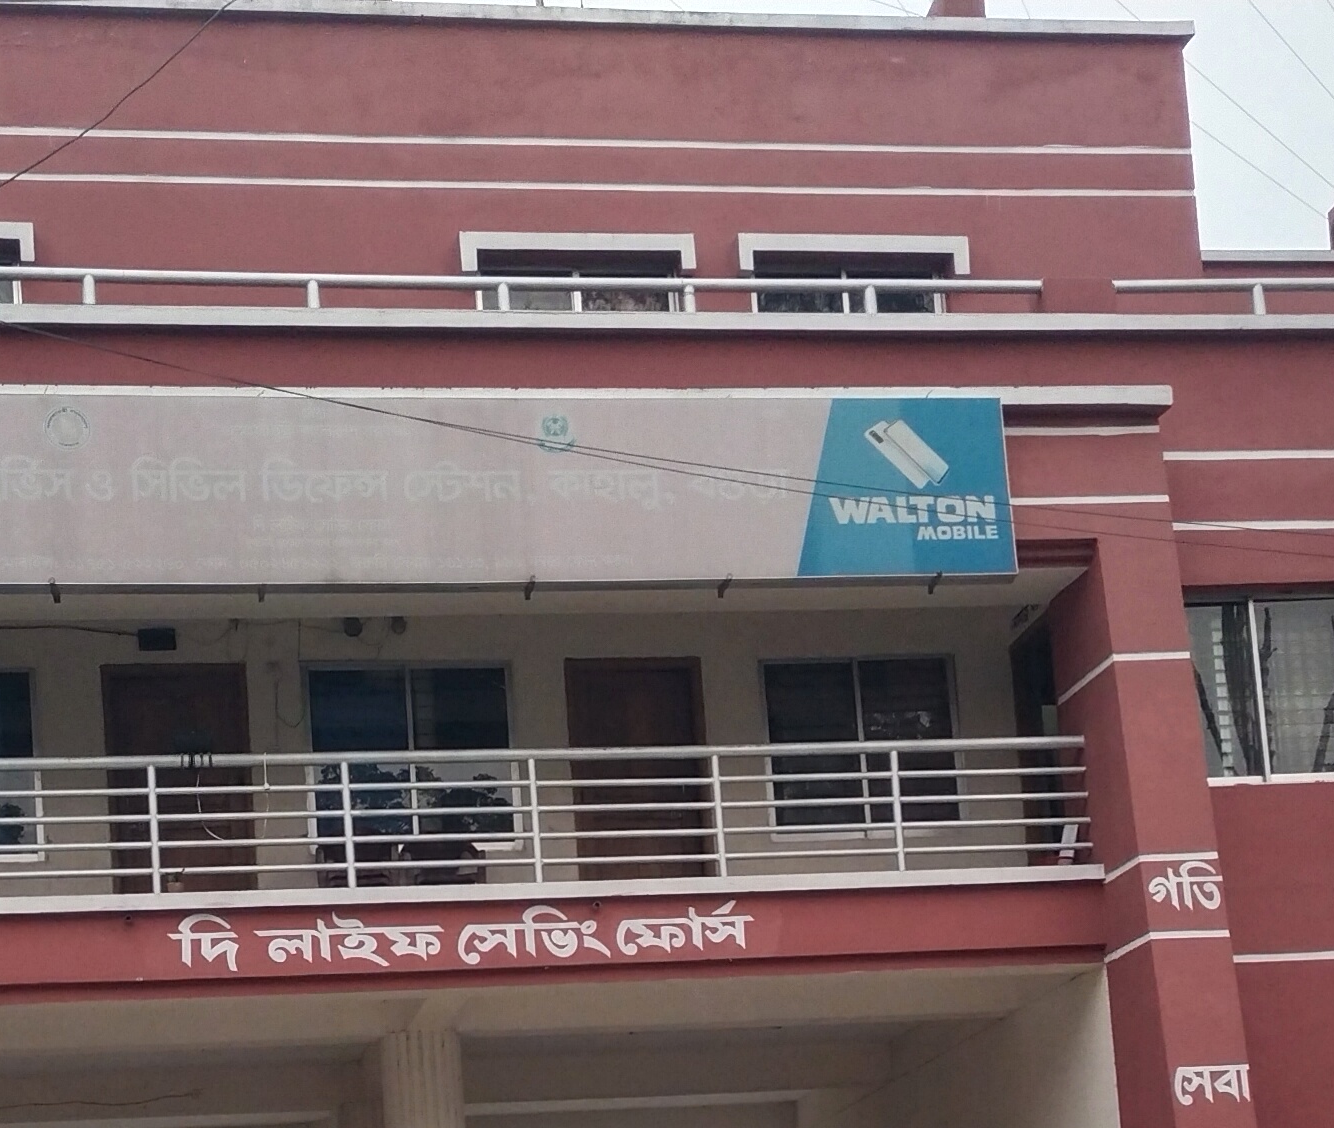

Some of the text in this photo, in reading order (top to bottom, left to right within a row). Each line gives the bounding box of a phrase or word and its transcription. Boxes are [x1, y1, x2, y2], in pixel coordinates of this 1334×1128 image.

[85, 469, 115, 501] ও
[829, 495, 997, 524] WALTON
[917, 525, 999, 541] MOBILE
[1148, 861, 1223, 911] গতি
[168, 900, 755, 972] দি লাইফ সেভিং ফোর্স
[1175, 1064, 1250, 1106] সেবা
